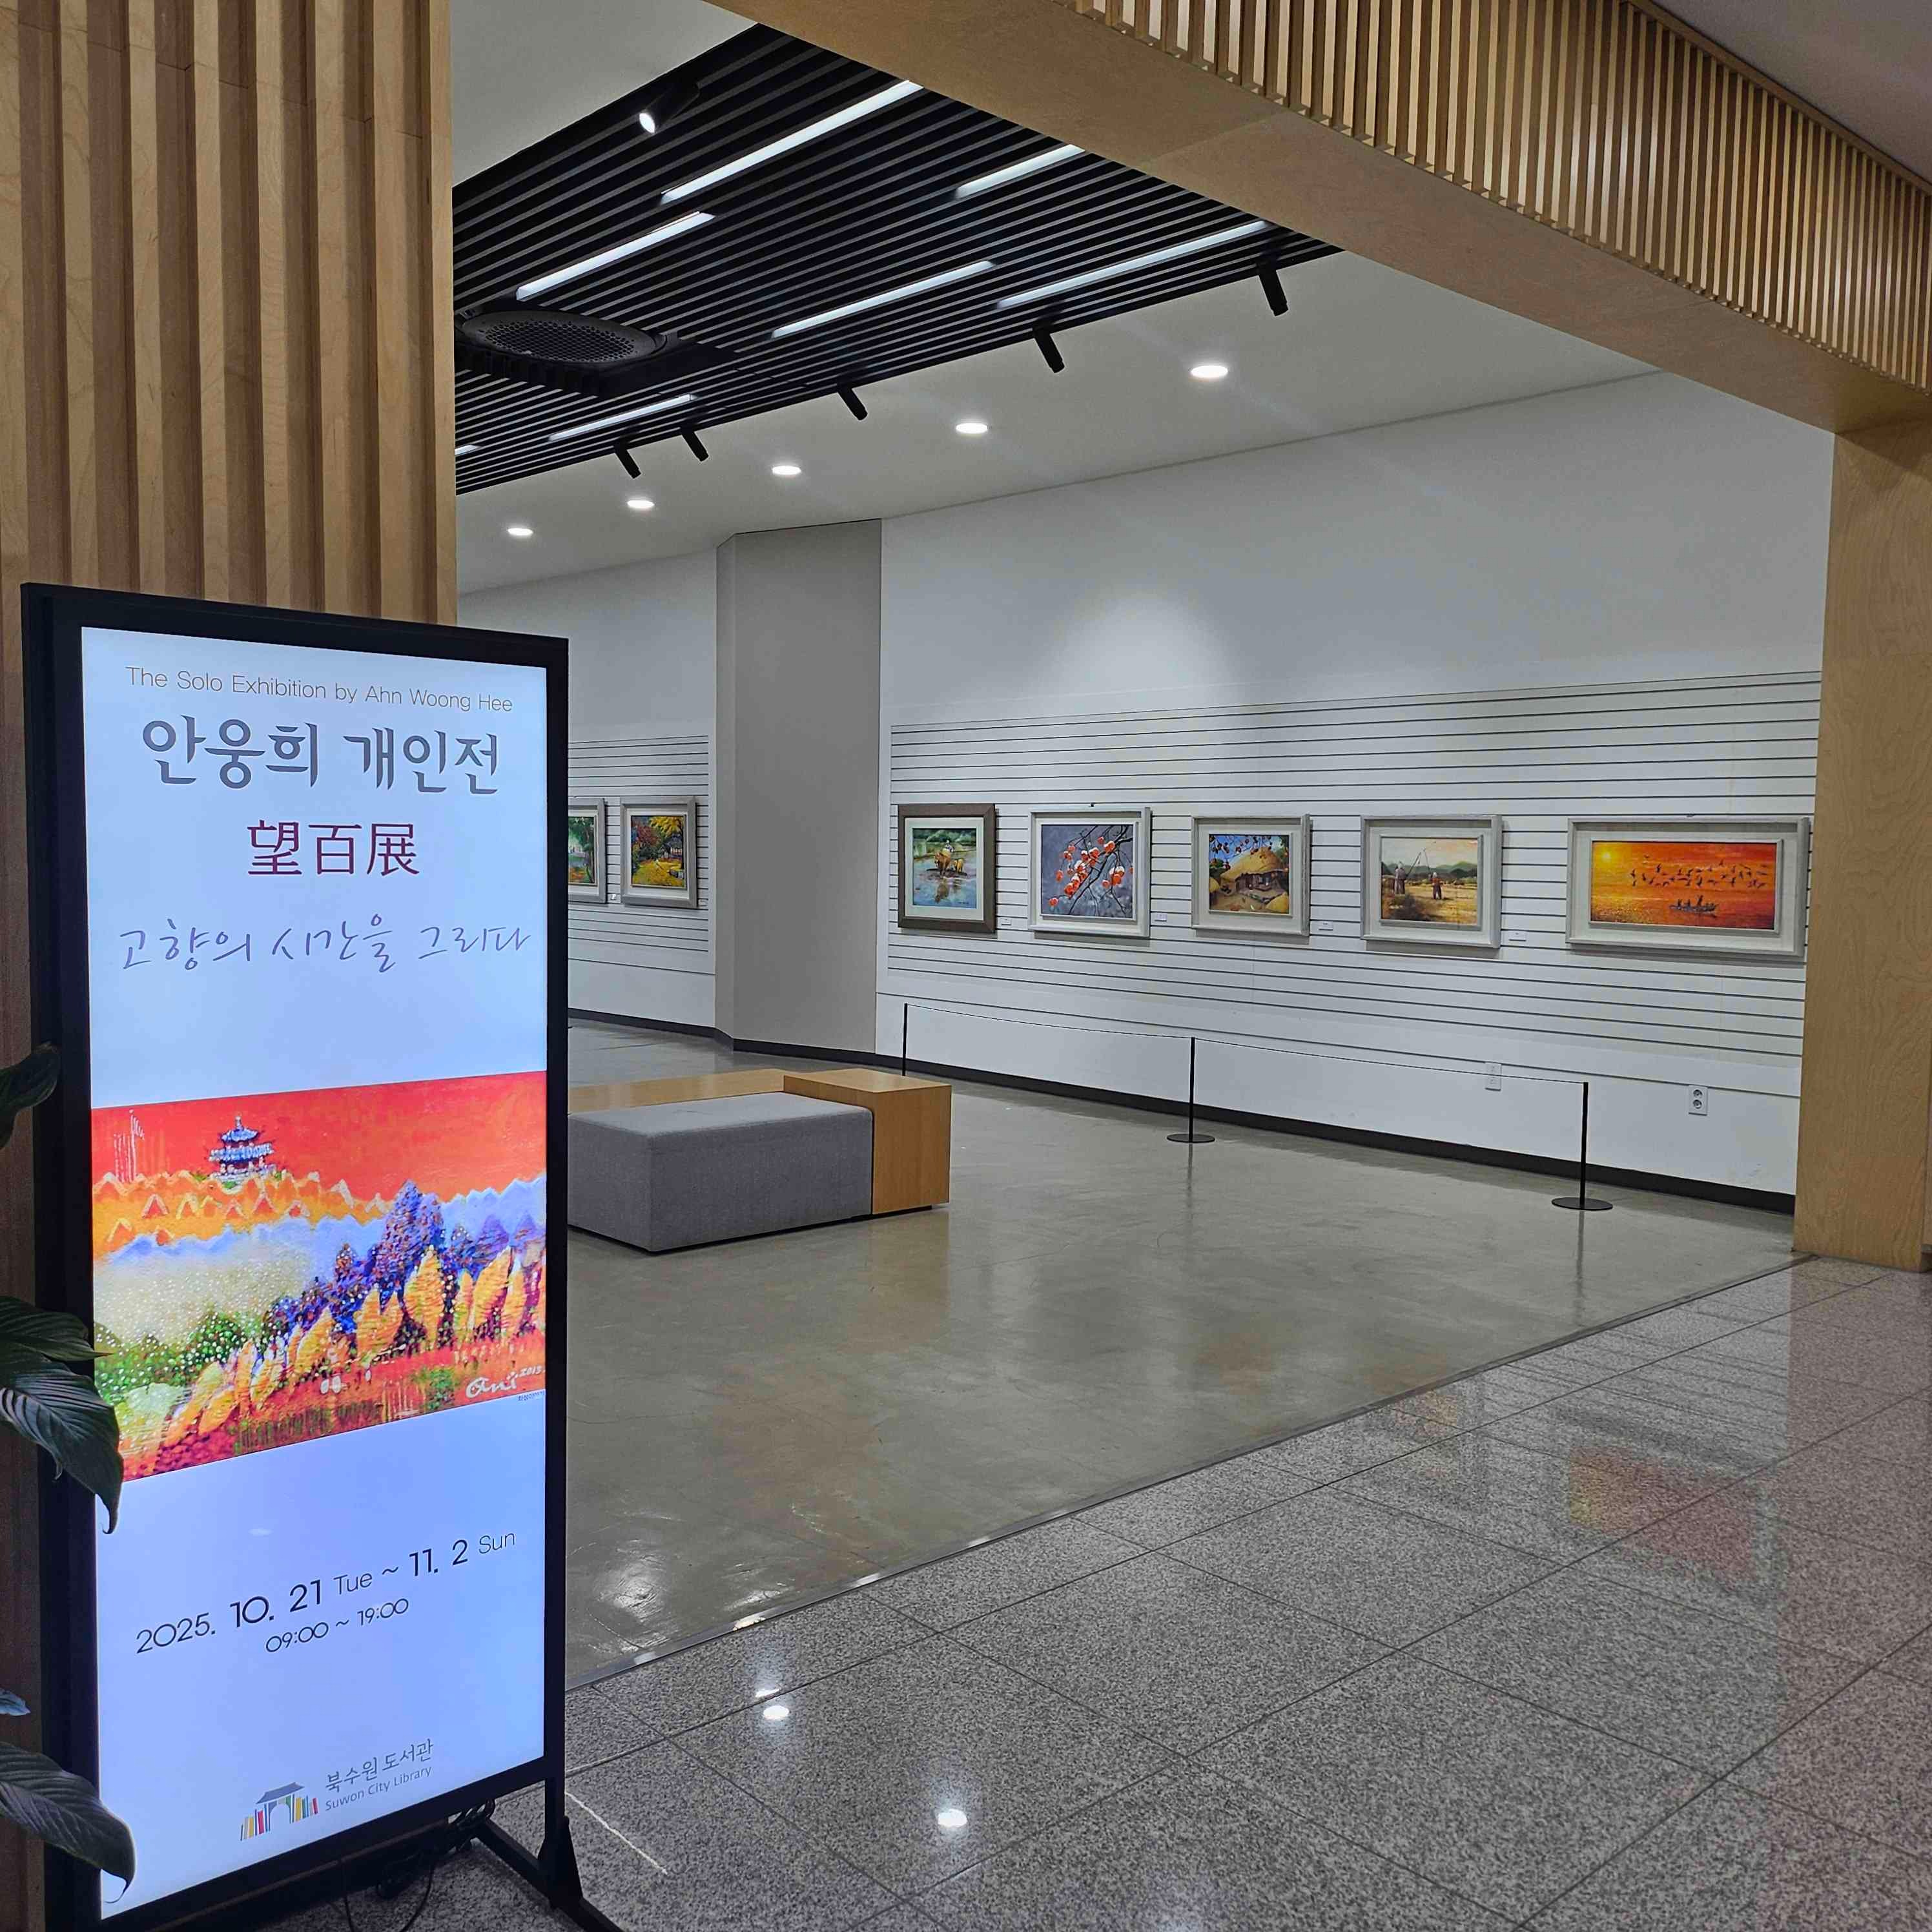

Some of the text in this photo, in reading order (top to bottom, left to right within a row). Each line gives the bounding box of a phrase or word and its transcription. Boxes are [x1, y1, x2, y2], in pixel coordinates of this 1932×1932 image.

[124, 666, 513, 712] The Solo Exhibition by Ahn Woong Hee
[142, 714, 498, 795] 안웅희 개인전
[246, 819, 421, 877] 望百展
[119, 913, 531, 973] 고향의 시간을 그리다
[136, 1612, 216, 1654] 2025.
[229, 1596, 275, 1629] 10.
[289, 1579, 322, 1613] 21
[333, 1572, 373, 1595] Tue
[409, 1548, 439, 1577] 11.
[451, 1539, 469, 1566] 2
[478, 1532, 516, 1555] Sun
[265, 1621, 329, 1653] 09:00
[356, 1598, 410, 1627] 19:00
[325, 1765, 433, 1811] Suwon City Library
